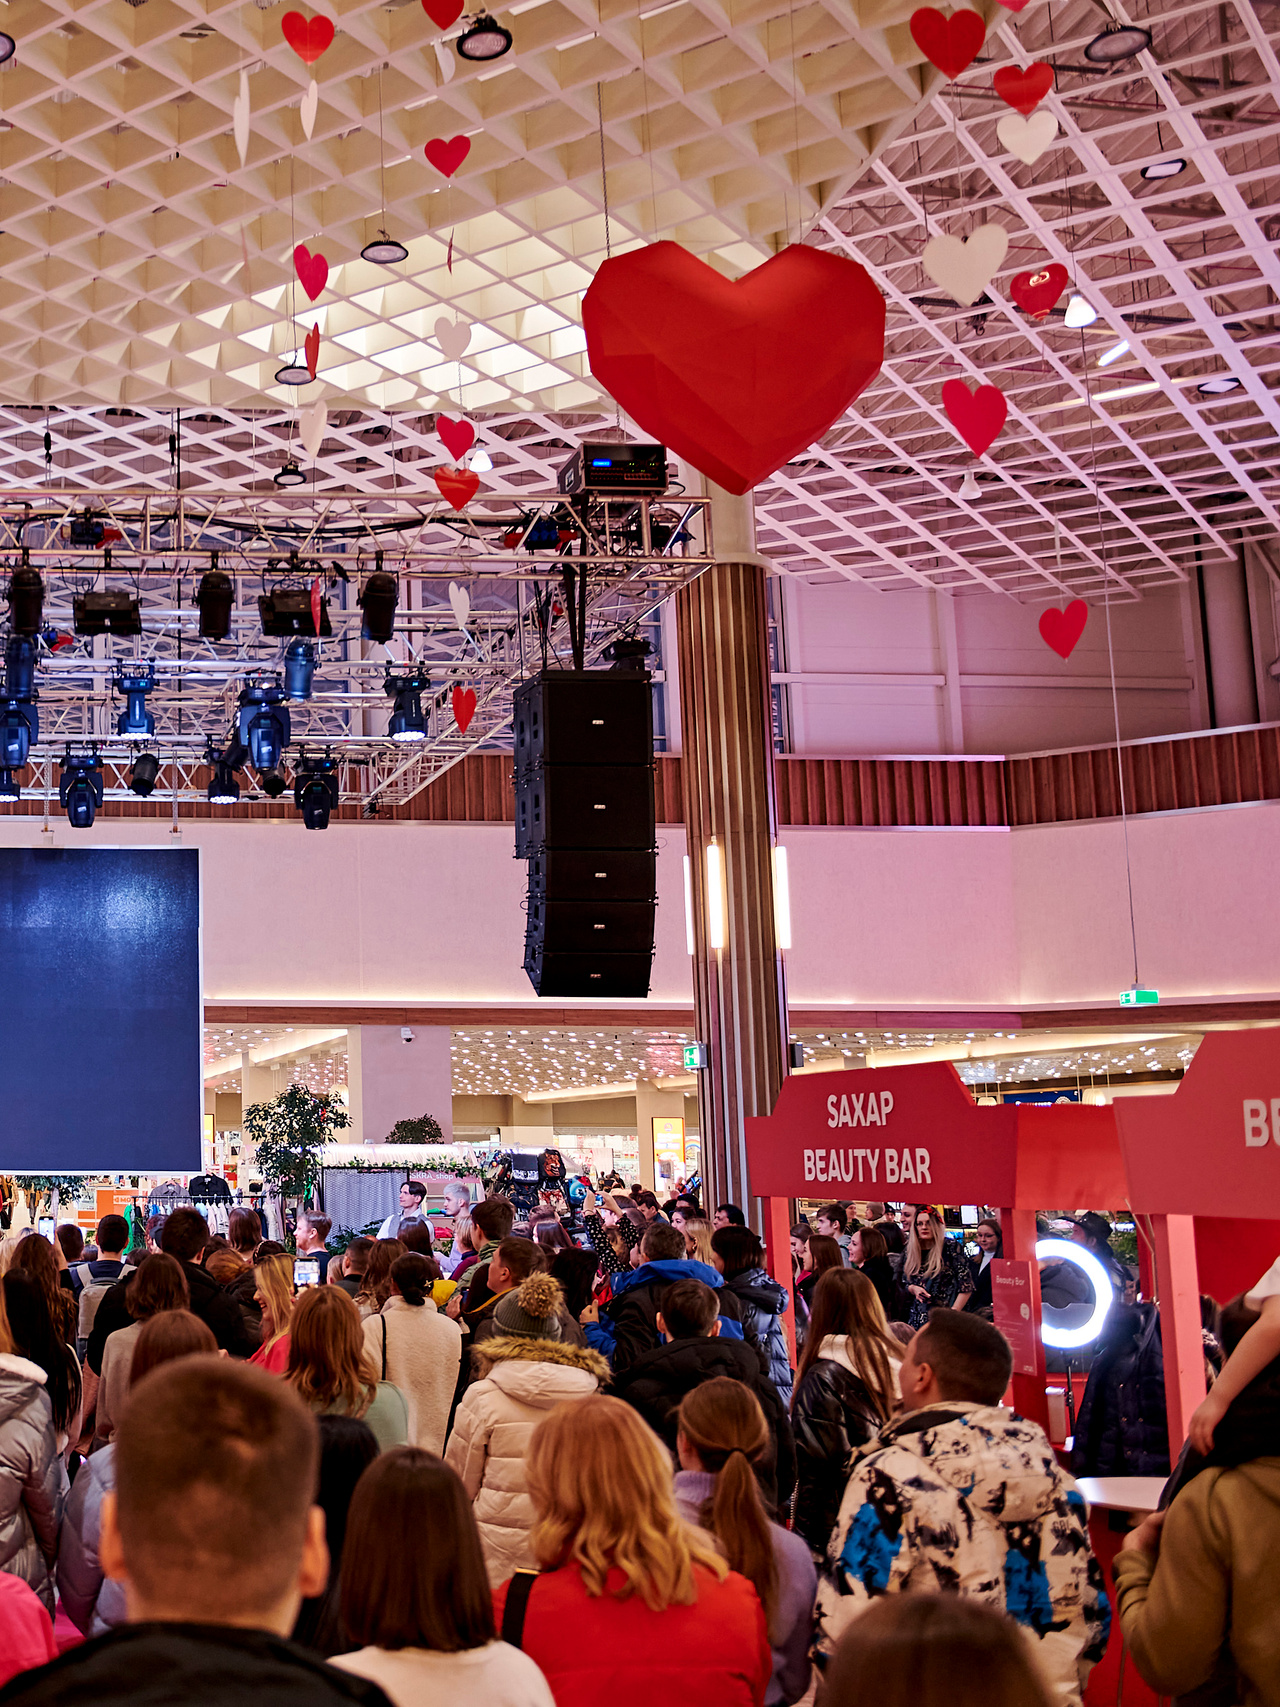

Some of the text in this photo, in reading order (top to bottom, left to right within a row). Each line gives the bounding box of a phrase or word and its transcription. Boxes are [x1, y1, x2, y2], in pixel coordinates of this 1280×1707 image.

[827, 1091, 894, 1128] SAXAP
[803, 1147, 932, 1184] BEAUTY BAR
